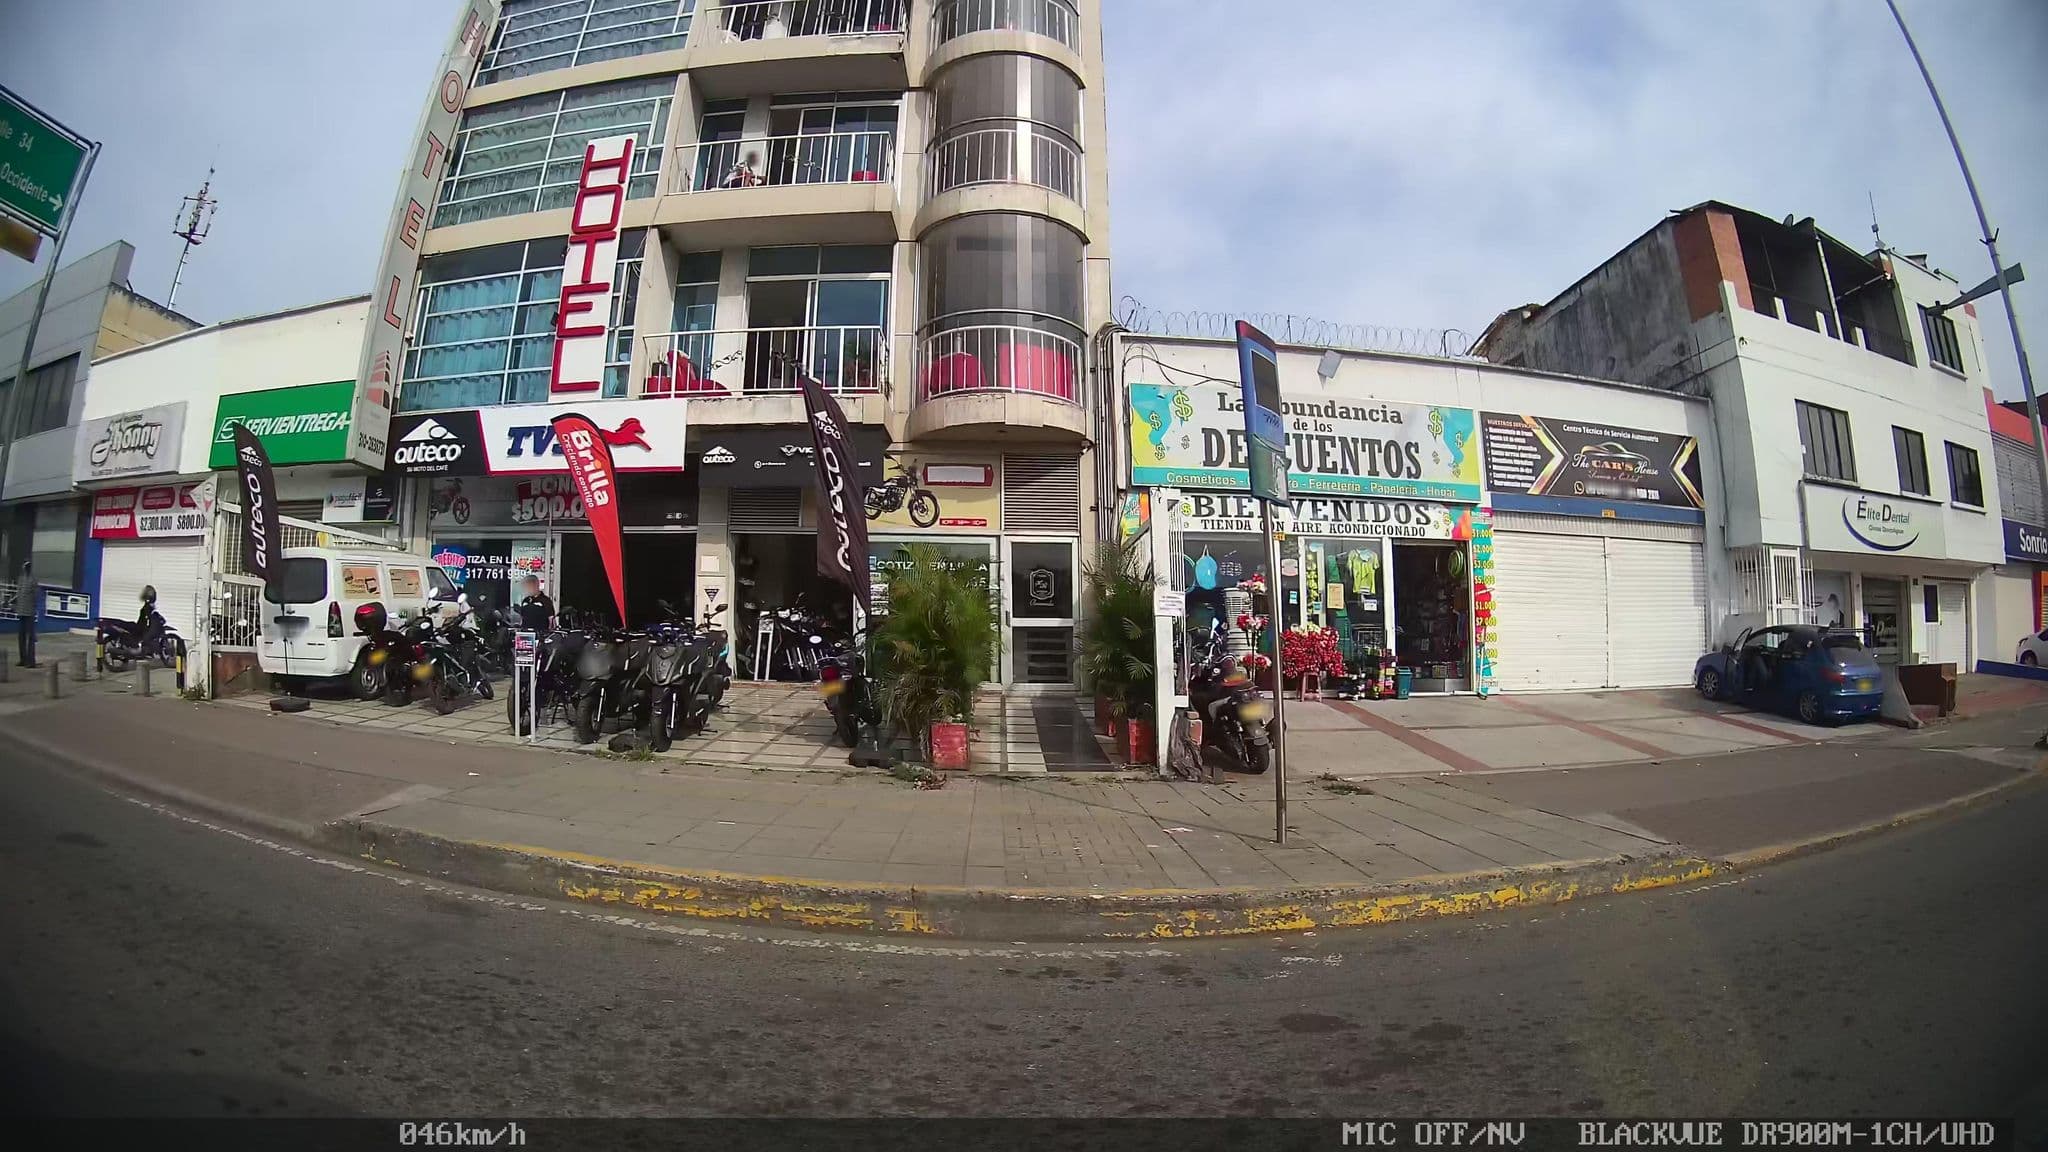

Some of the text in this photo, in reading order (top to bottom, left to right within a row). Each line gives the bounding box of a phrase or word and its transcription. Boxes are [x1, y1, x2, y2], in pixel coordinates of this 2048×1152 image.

[19, 132, 34, 152] 34
[384, 8, 487, 329] HOTEL
[0, 162, 48, 202] Occidente
[551, 138, 633, 392] HOTEL
[1217, 392, 1403, 425] La bundancia
[245, 412, 345, 436] SERVIENTREGA
[1293, 419, 1333, 433] de los
[1562, 424, 1582, 433] Centro
[395, 442, 463, 464] auteco
[703, 455, 736, 464] auteco
[1201, 428, 1422, 480] DEUENTOS
[1572, 453, 1659, 475] The CAR'S House
[562, 434, 594, 508] Creciendo contigo
[569, 430, 610, 506] Brilla
[1166, 472, 1236, 485] Cosméticos
[531, 475, 577, 496] BON
[247, 468, 266, 568] auteco
[512, 496, 587, 524] $500.0
[1857, 496, 1910, 523] Élite Dental
[1201, 519, 1252, 531] TIENDA
[1292, 522, 1322, 533] AIRE
[1329, 523, 1426, 537] ACONDICIONADO
[467, 555, 486, 564] TIZA
[490, 555, 502, 564] EN
[877, 561, 914, 570] COTIZ
[466, 568, 483, 579] 317
[486, 568, 503, 579] 761
